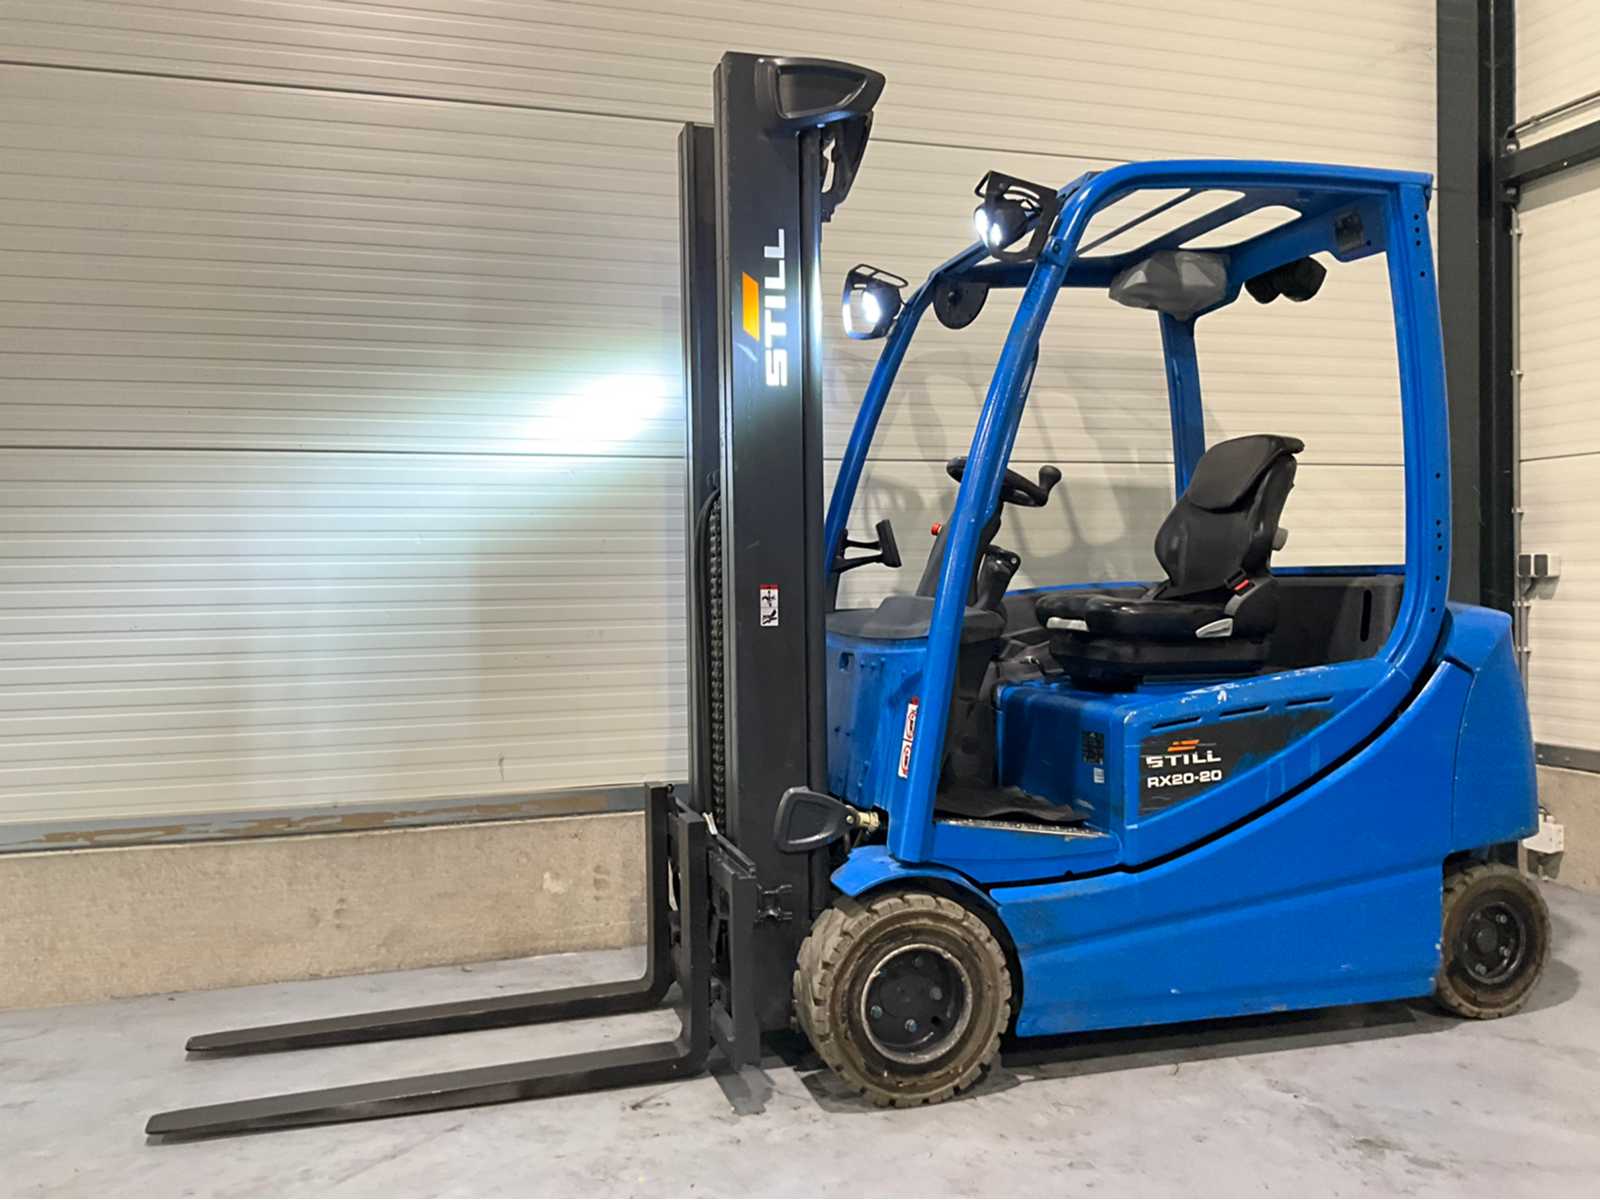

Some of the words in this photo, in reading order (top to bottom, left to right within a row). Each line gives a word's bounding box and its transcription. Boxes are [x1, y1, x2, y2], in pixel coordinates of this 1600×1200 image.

[764, 229, 787, 387] STILL
[1146, 750, 1221, 769] STILL
[1147, 769, 1222, 789] RX20-20
